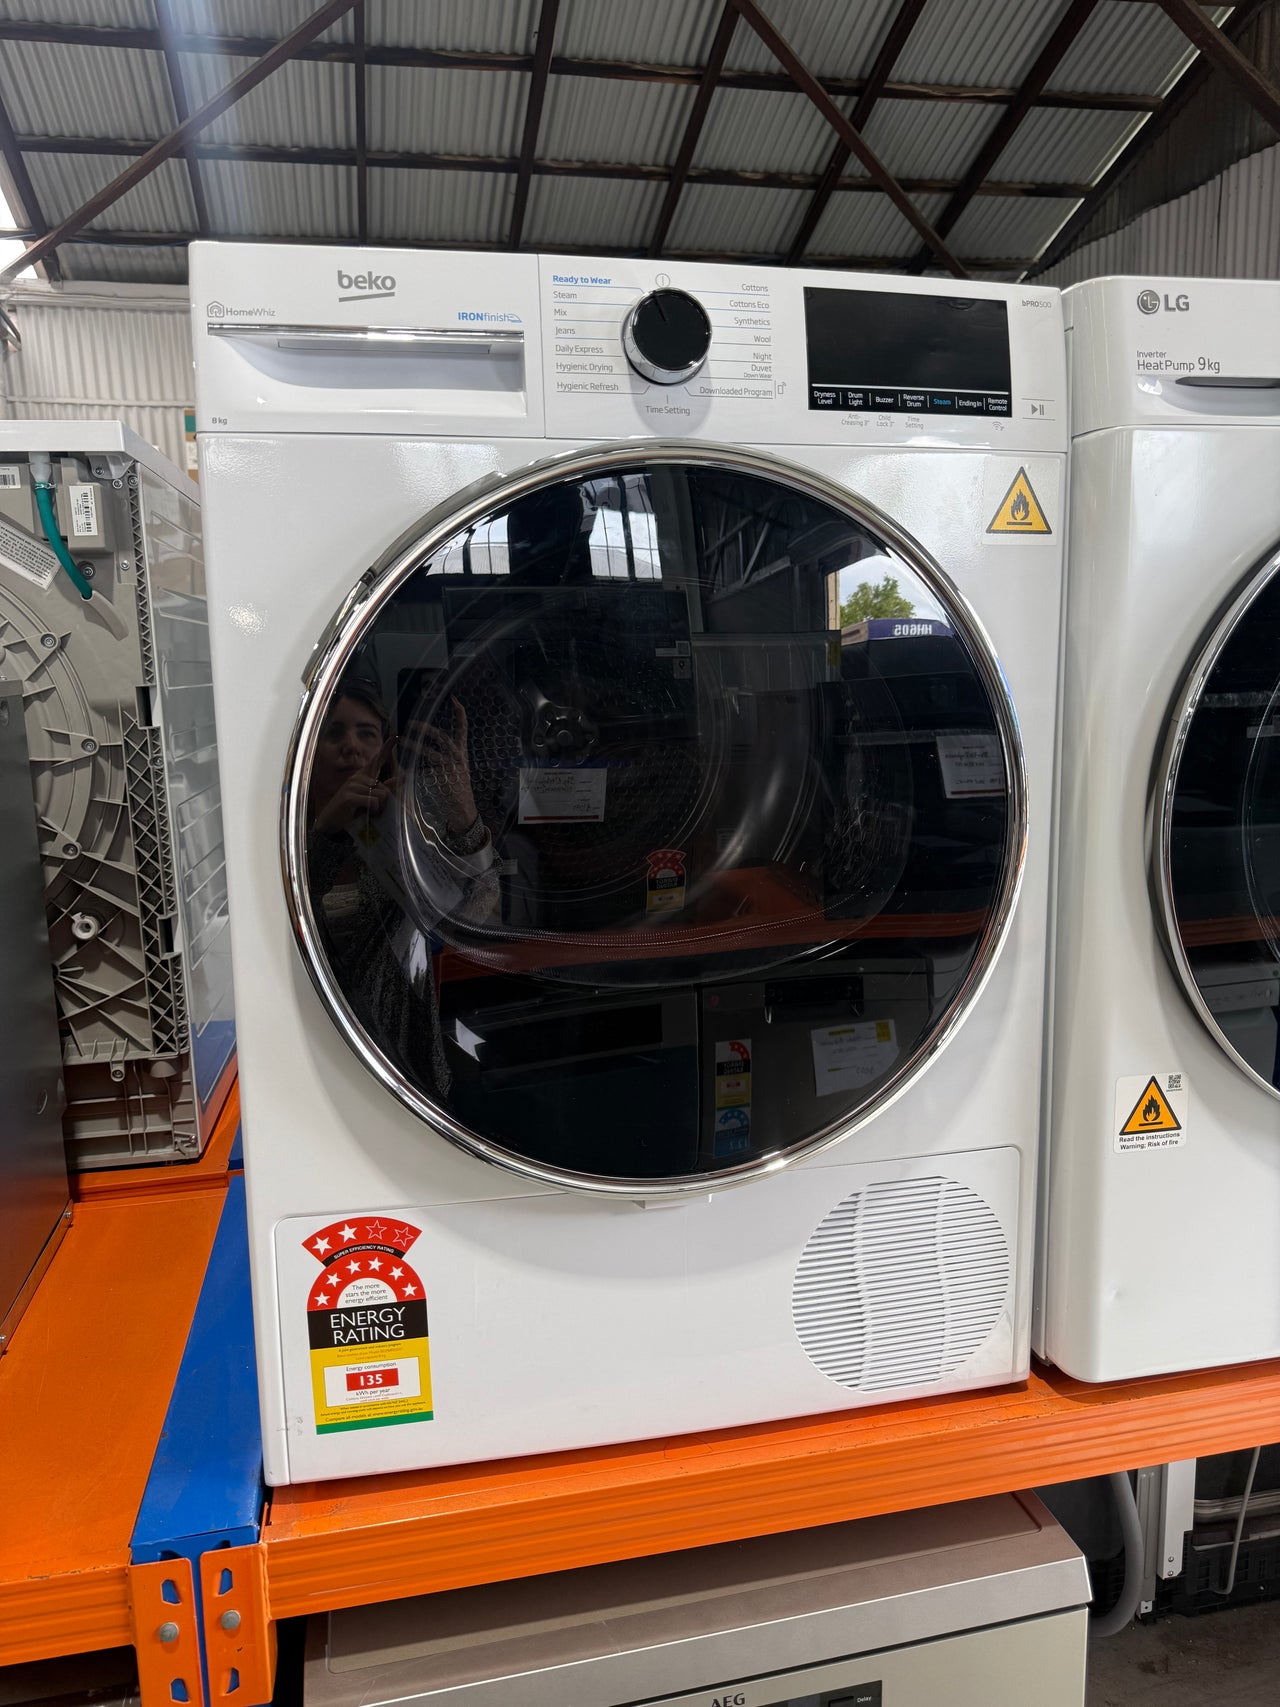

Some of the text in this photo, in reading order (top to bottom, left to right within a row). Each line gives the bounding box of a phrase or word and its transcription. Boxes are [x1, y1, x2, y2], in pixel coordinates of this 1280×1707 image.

[337, 270, 396, 291] beko
[553, 275, 612, 285] Ready to Wear
[742, 284, 769, 292] Cottons
[553, 291, 577, 299] Steam
[729, 300, 757, 308] Cottons
[1164, 294, 1190, 312] LG
[225, 307, 276, 318] HomeWhiz
[554, 308, 568, 316] Mix
[457, 312, 511, 322] IRONfinish
[734, 317, 771, 326] Synthetics
[555, 327, 576, 335] Jeans
[555, 345, 604, 354] Daily Express
[1136, 350, 1167, 358] Inverter
[753, 352, 772, 361] Night
[556, 362, 613, 372] Hygienic Drying
[751, 364, 772, 372] Duvet
[1198, 357, 1206, 371] 9
[1207, 359, 1221, 374] kg
[557, 382, 619, 391] Hygienic Refresh
[700, 386, 773, 397] Downloaded Program
[813, 391, 836, 399] Dryness
[959, 400, 977, 408] Ending
[646, 406, 691, 415] Time Setting
[211, 417, 228, 426] 8 kg
[1145, 1132, 1180, 1140] instructions
[333, 1245, 395, 1259] SUPER EFFICIENCY RATING
[330, 1306, 406, 1329] ENERGY
[333, 1323, 405, 1345] RATING
[364, 1361, 397, 1369] consumption
[360, 1373, 383, 1386] 135
[711, 1692, 746, 1707] AEG
